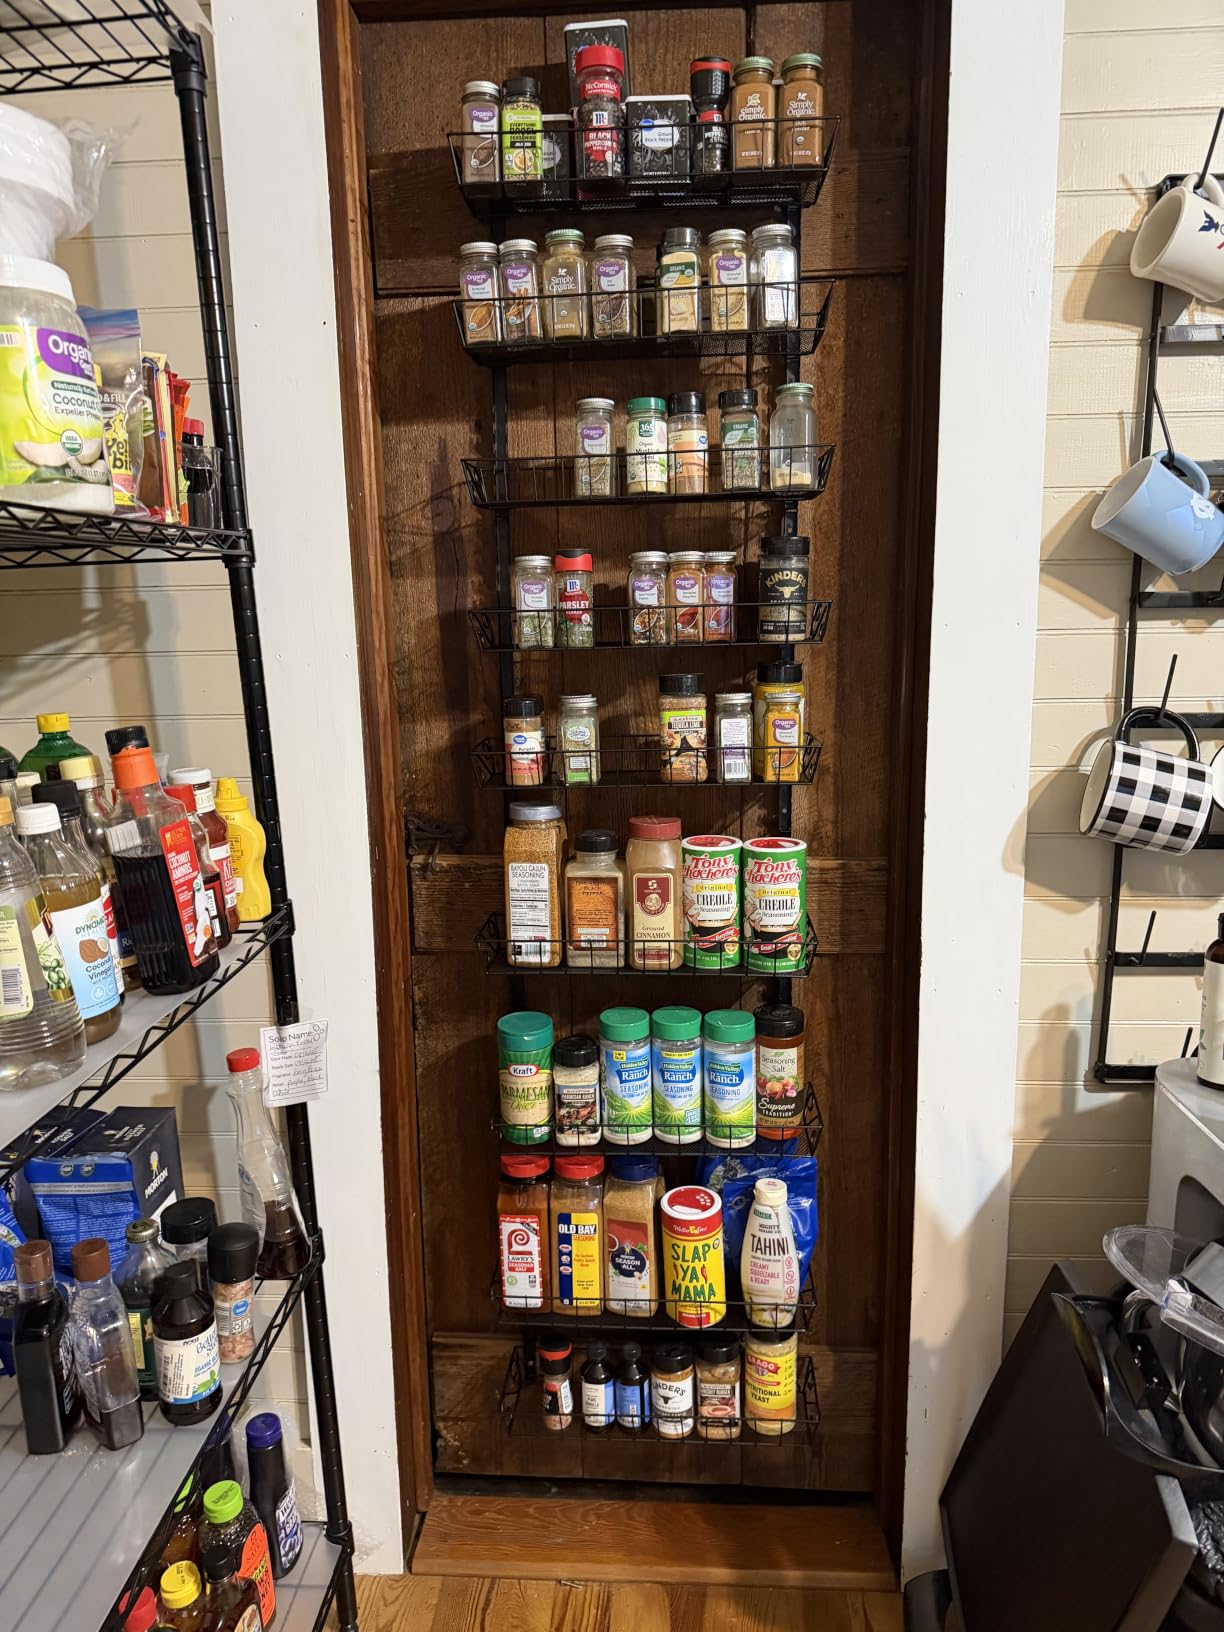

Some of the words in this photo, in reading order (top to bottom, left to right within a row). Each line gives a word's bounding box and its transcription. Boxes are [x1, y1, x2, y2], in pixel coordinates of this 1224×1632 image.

[586, 82, 617, 90] McCormick
[740, 106, 764, 114] Simply
[790, 100, 814, 110] Simply
[738, 112, 768, 120] Organic
[787, 108, 816, 118] Organic
[589, 132, 612, 140] BLACK
[719, 260, 740, 268] Organic
[506, 268, 528, 276] Organic
[466, 274, 487, 282] Organic
[551, 276, 574, 284] Simply
[549, 282, 576, 292] Organic
[54, 382, 82, 393] Naturally
[52, 392, 95, 410] Coconut
[111, 394, 126, 403] FILL
[54, 406, 84, 418] Expeller
[584, 428, 604, 436] Organic
[640, 422, 654, 432] 365
[559, 600, 589, 608] PARSLEY
[169, 850, 191, 869] COCONUT
[691, 854, 734, 869] Tony
[510, 864, 528, 872] BAYOU
[754, 858, 797, 874] Tony
[172, 862, 193, 881] AMINOS
[696, 892, 733, 906] CREOLE
[758, 898, 796, 911] CREOLE
[75, 916, 104, 935] DYNAMIC
[86, 958, 112, 973] Coconut
[88, 964, 112, 980] Vinegar
[268, 1035, 288, 1044] Soap
[762, 1055, 796, 1064] Seasoning
[513, 1067, 533, 1075] Kraft
[622, 1068, 648, 1080] Ranch
[664, 1071, 693, 1081] Ranch
[710, 1072, 740, 1084] Ranch
[620, 1081, 648, 1092] SEASONING
[664, 1085, 694, 1093] SEASONING
[502, 1086, 550, 1102] PARMESAN
[758, 1098, 796, 1111] Supreme
[762, 1110, 792, 1118] TRADITION
[144, 1167, 168, 1200] MORTON
[558, 1224, 576, 1234] OLD
[578, 1224, 596, 1234] BAY
[750, 1234, 790, 1256] TAHINI
[672, 1243, 711, 1264] SLAP
[616, 1258, 641, 1266] SEASON
[750, 1260, 770, 1271] CREAMY
[680, 1264, 700, 1284] YA
[750, 1268, 780, 1280] SQUEEZABLE
[754, 1276, 770, 1286] READY
[672, 1280, 716, 1302] MAMA
[751, 1392, 770, 1404] YEAST
